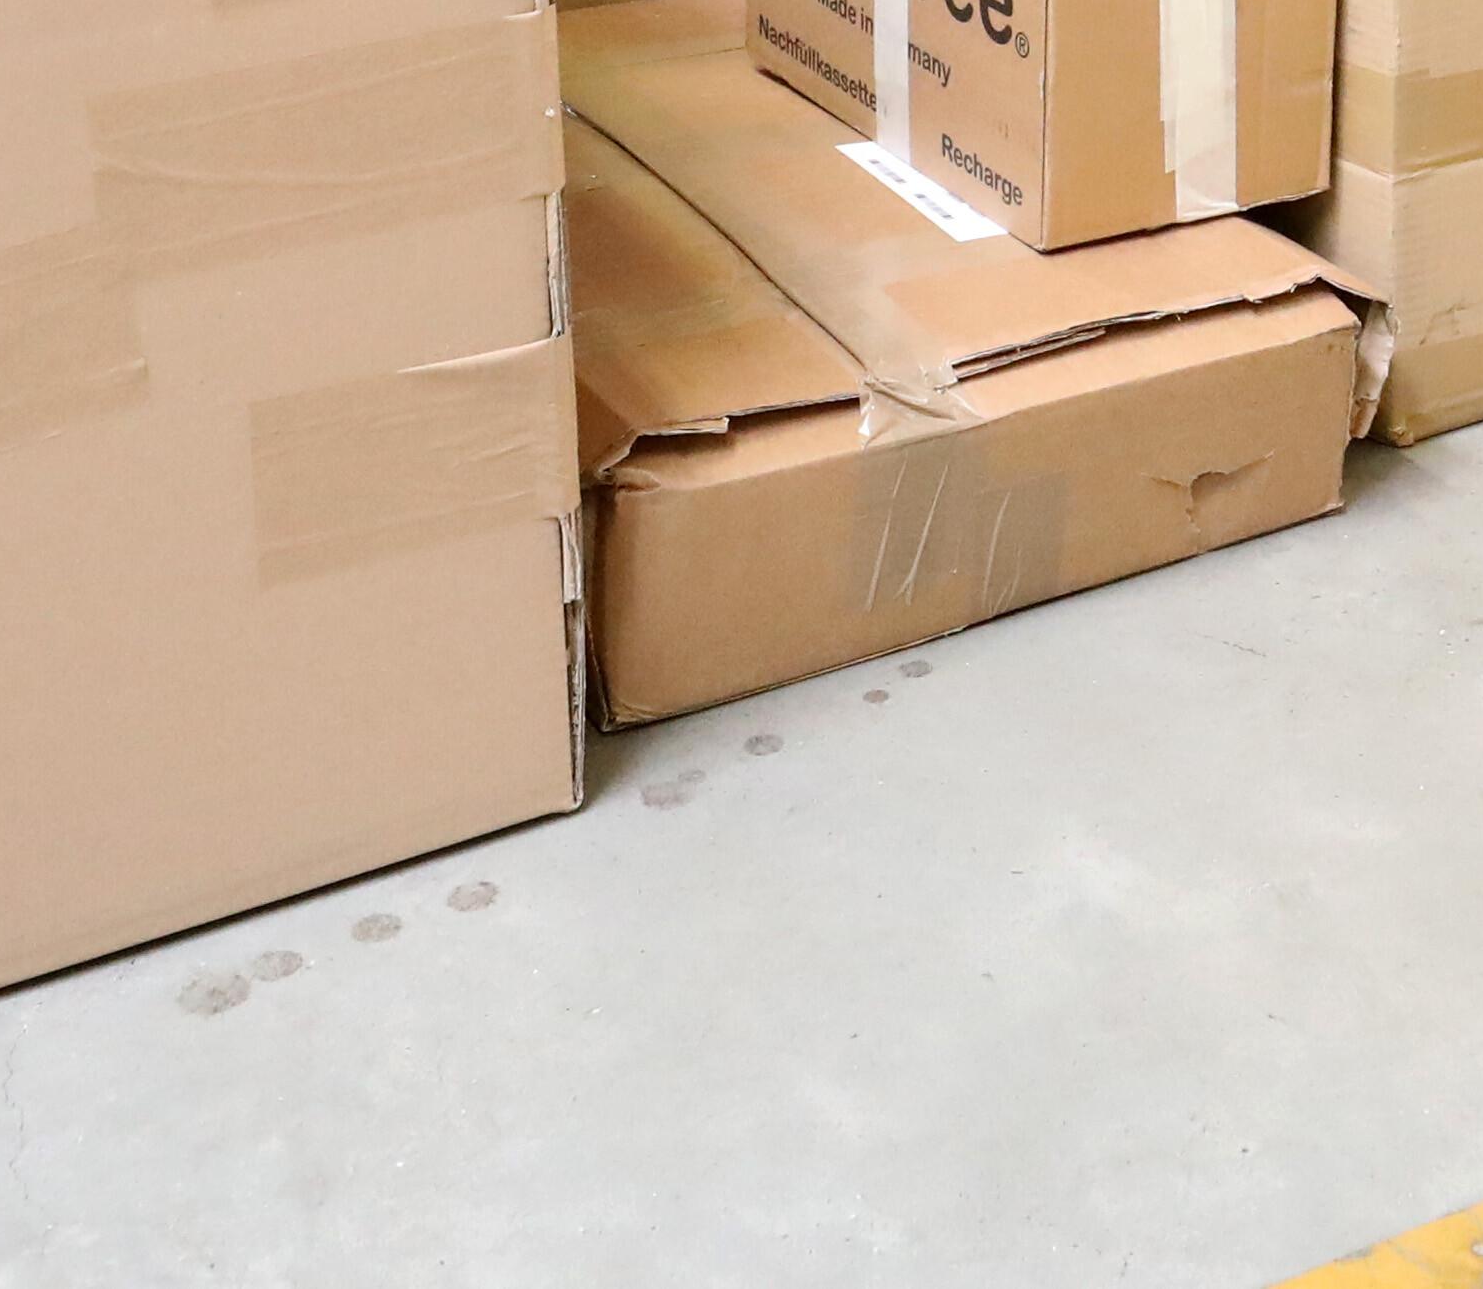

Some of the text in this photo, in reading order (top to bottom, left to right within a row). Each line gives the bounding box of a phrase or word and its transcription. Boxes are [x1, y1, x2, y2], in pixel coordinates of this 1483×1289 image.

[860, 6, 874, 36] in
[908, 41, 952, 89] many
[941, 132, 1024, 207] Recharge
